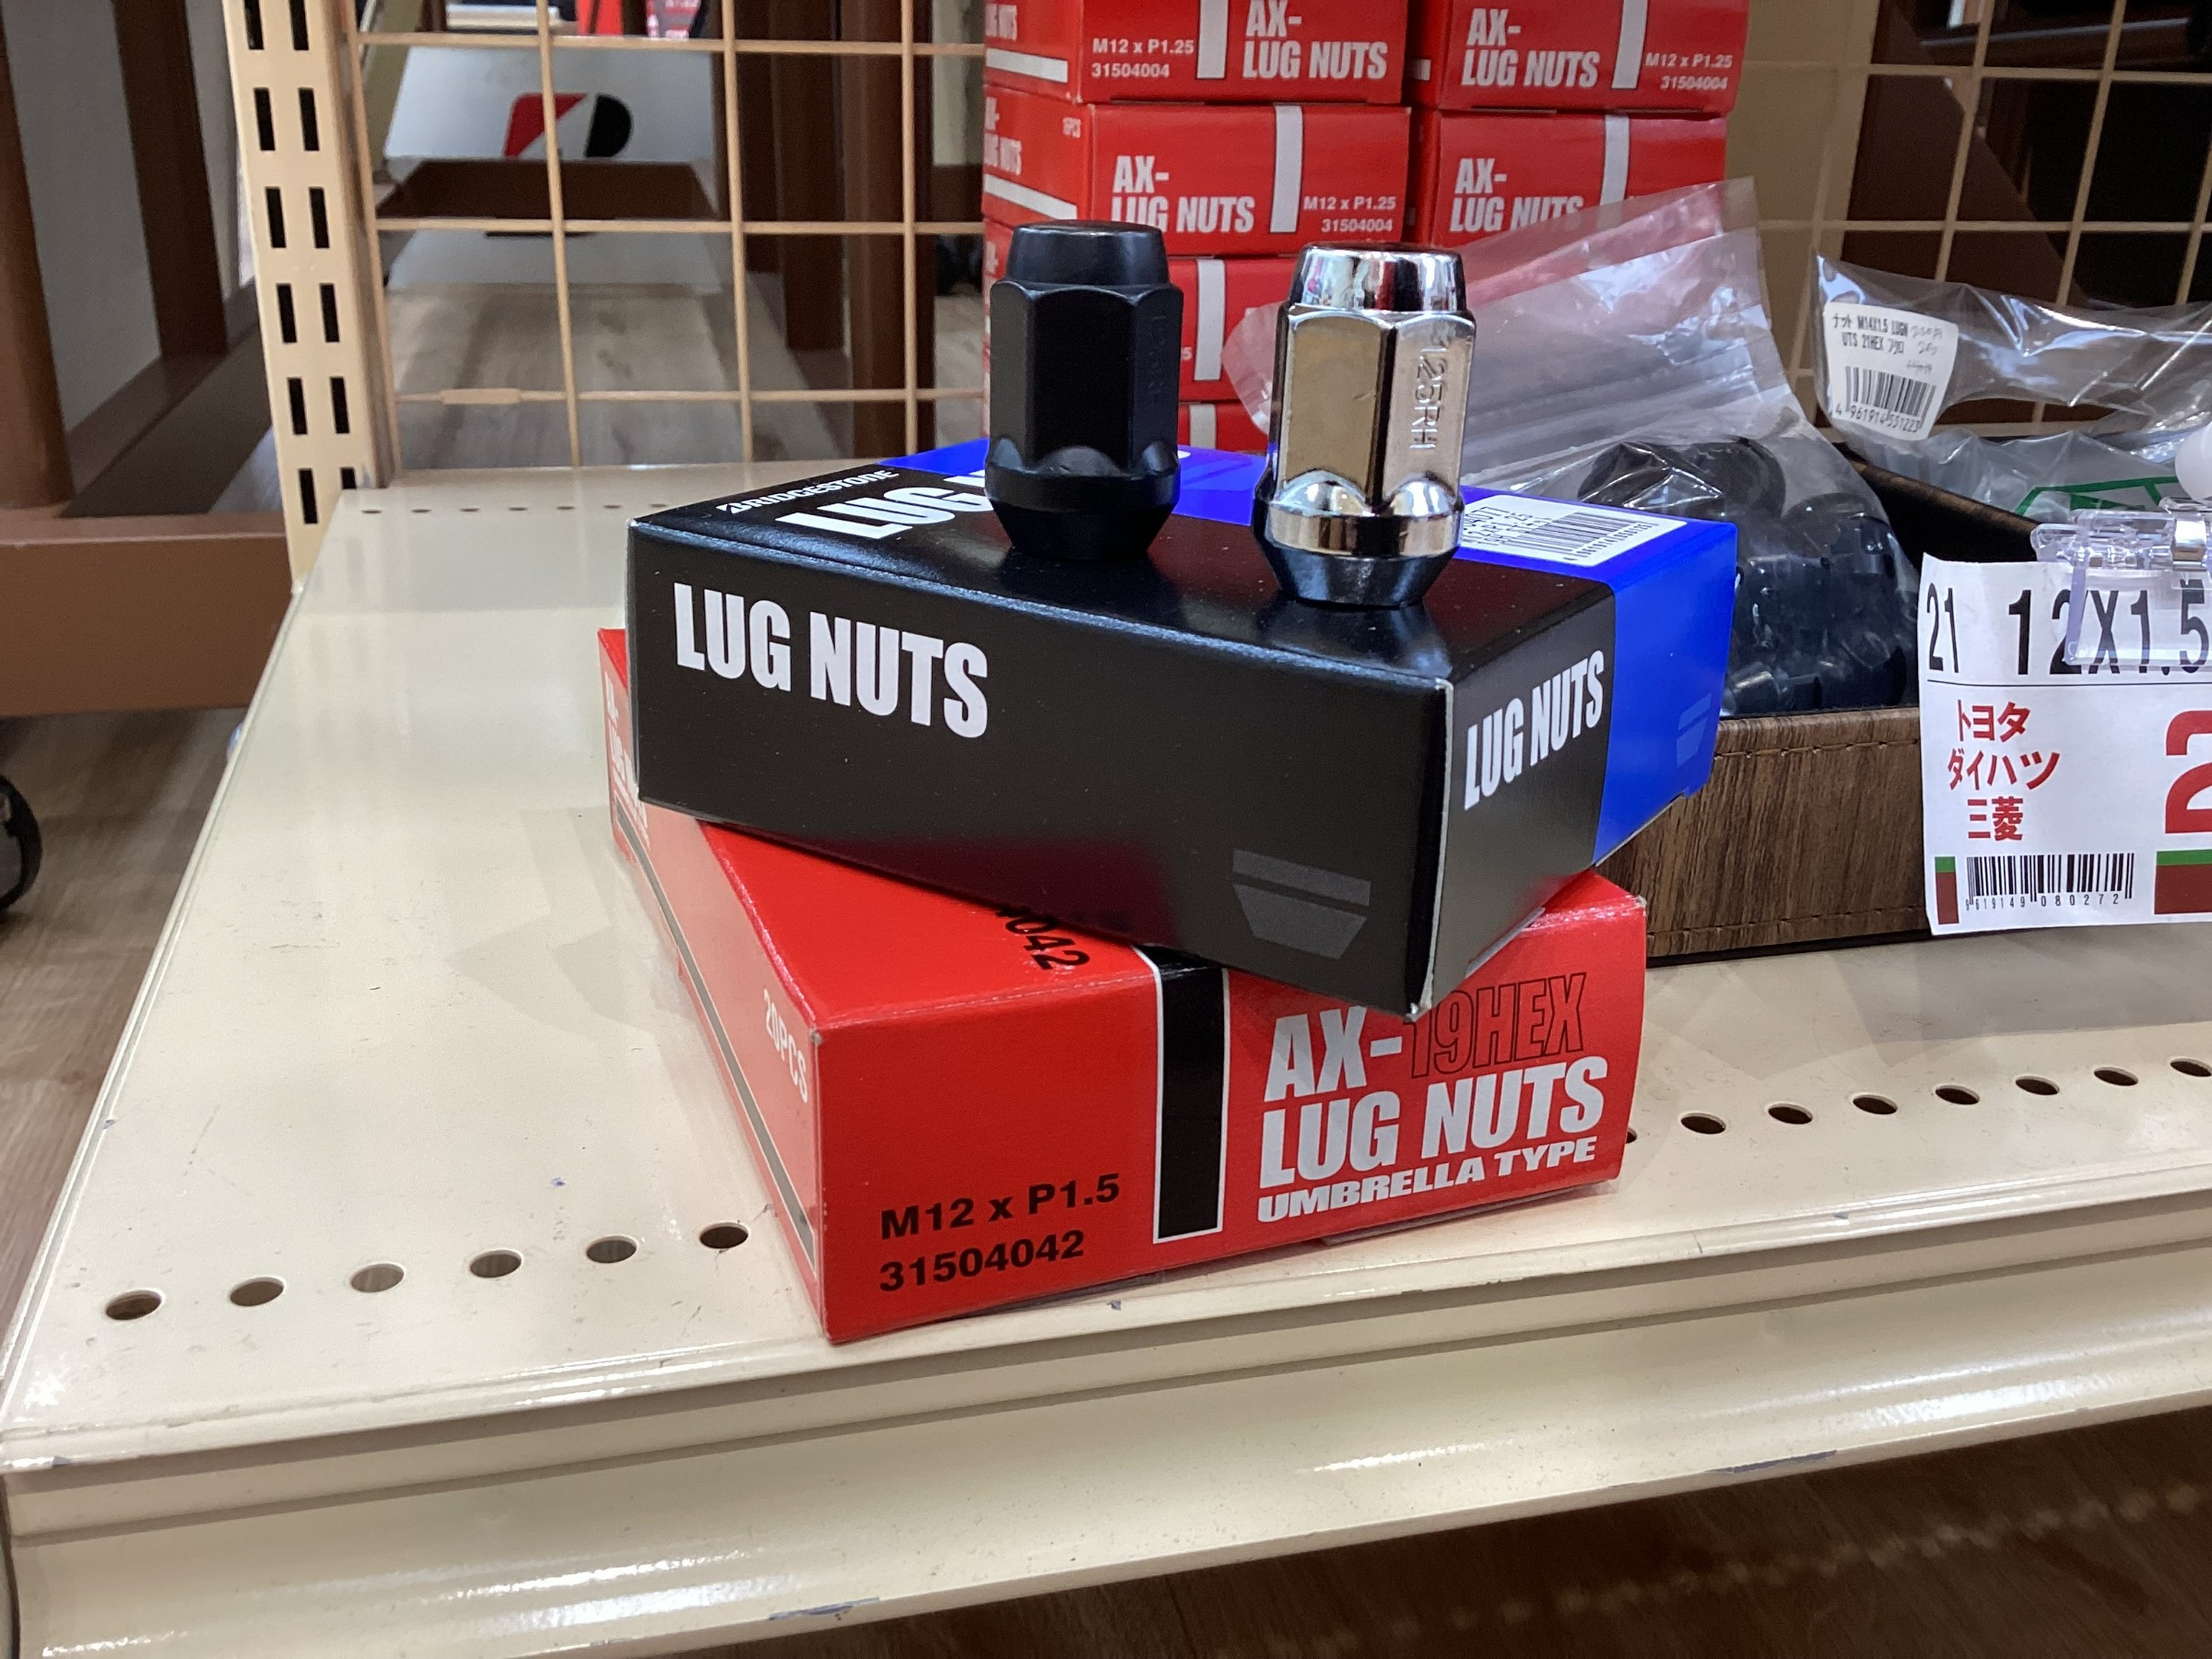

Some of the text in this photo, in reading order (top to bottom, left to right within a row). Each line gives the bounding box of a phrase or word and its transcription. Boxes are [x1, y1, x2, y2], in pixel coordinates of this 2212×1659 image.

[1245, 0, 1302, 38] AX-
[1466, 8, 1522, 46] AX-
[1092, 39, 1194, 54] M12 x P1.25
[1242, 41, 1389, 80] LUG NUTS
[1645, 53, 1734, 70] M12 x P1.25
[1091, 63, 1171, 78] 31504004
[1462, 49, 1601, 88] LUG NUTS
[1661, 76, 1729, 91] 31504004
[1113, 155, 1170, 194] AX-
[1454, 158, 1508, 194] AX-
[1111, 196, 1255, 233] LUG NUTS
[1302, 195, 1397, 211] M12 x P1.25
[1450, 196, 1504, 233] LUG
[1321, 218, 1394, 233] 31504004
[1836, 403, 1842, 416] 4
[716, 468, 900, 515] BRIDGESTONE
[775, 487, 994, 540] LUG
[1926, 582, 1960, 674] 21
[674, 582, 989, 739] LUG NUTS
[1464, 650, 1606, 811] LUG NUTS
[1957, 699, 2032, 744] トヨタ
[1947, 747, 2061, 792] ダイハツ
[1967, 795, 2025, 842] 三菱
[763, 988, 808, 1103] 20PCS
[1259, 1055, 1608, 1189] LUG NUTS
[1257, 1135, 1598, 1224] UMBRELLA TYPE
[880, 1172, 1121, 1241] M12 x P1.5
[878, 1229, 1085, 1292] 31504042
